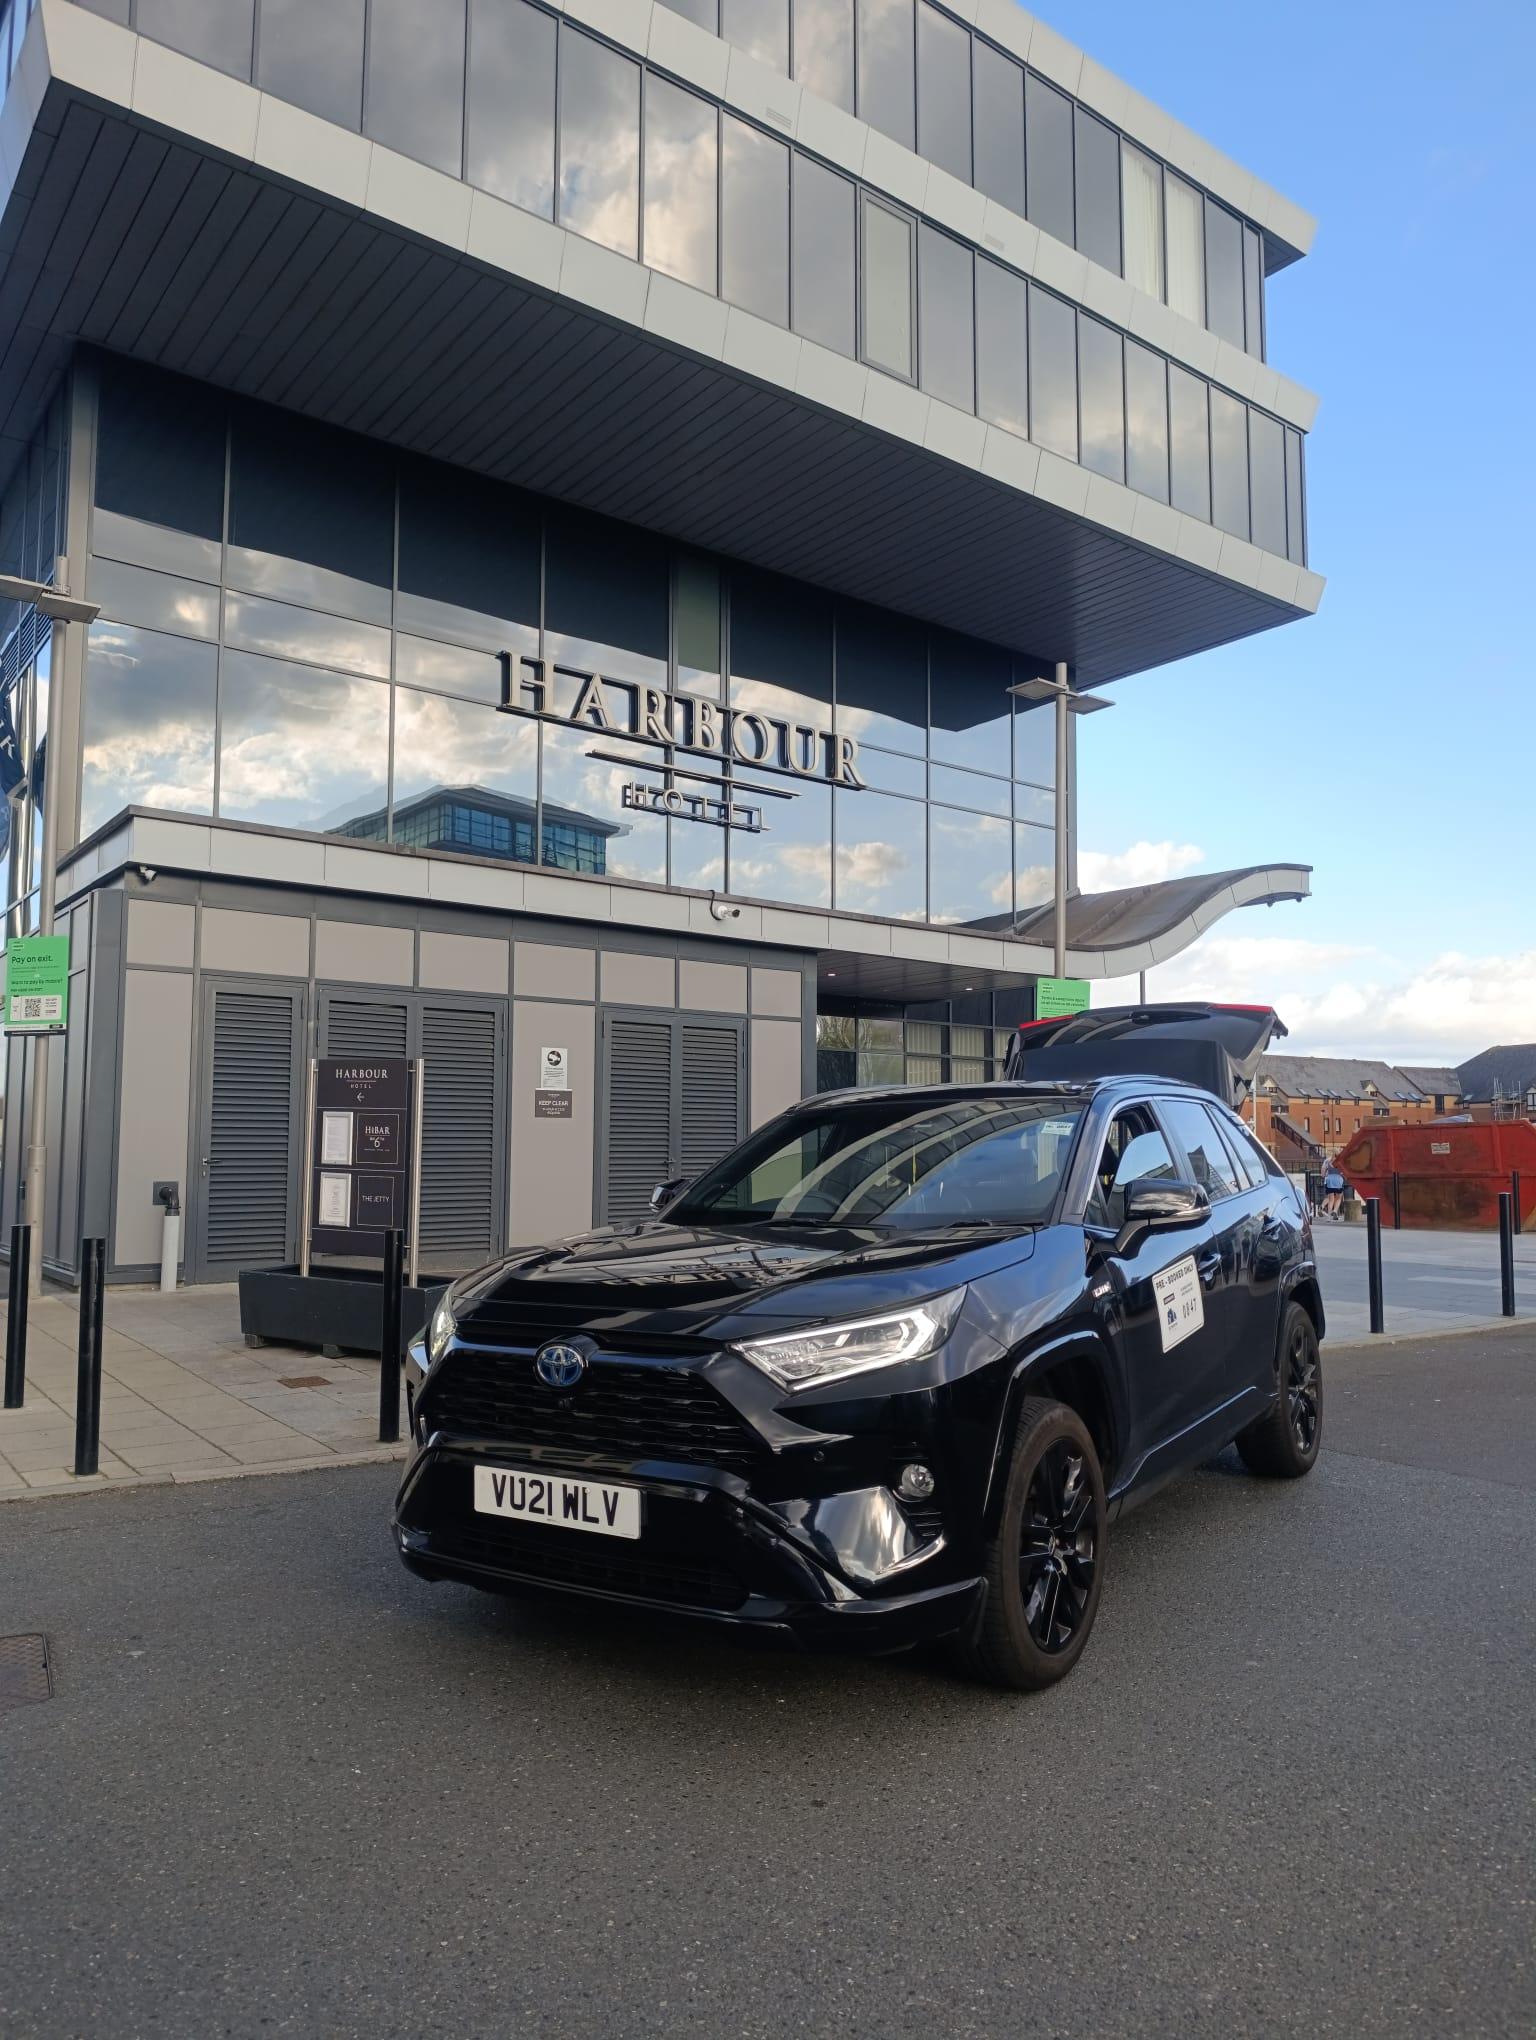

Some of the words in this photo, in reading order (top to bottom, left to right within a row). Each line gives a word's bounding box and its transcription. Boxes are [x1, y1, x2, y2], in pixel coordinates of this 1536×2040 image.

[502, 650, 867, 787] HARBOUR
[630, 781, 770, 831] HOTEL
[11, 956, 25, 965] Pay
[37, 954, 54, 962] exit.
[335, 1069, 389, 1079] HARBOUR
[373, 1195, 390, 1203] JETTY
[1155, 1279, 1165, 1290] PRE
[1167, 1269, 1184, 1285] BOOKED
[1183, 1263, 1194, 1275] ONLY
[491, 1473, 553, 1516] VU21
[562, 1483, 619, 1527] WLV
